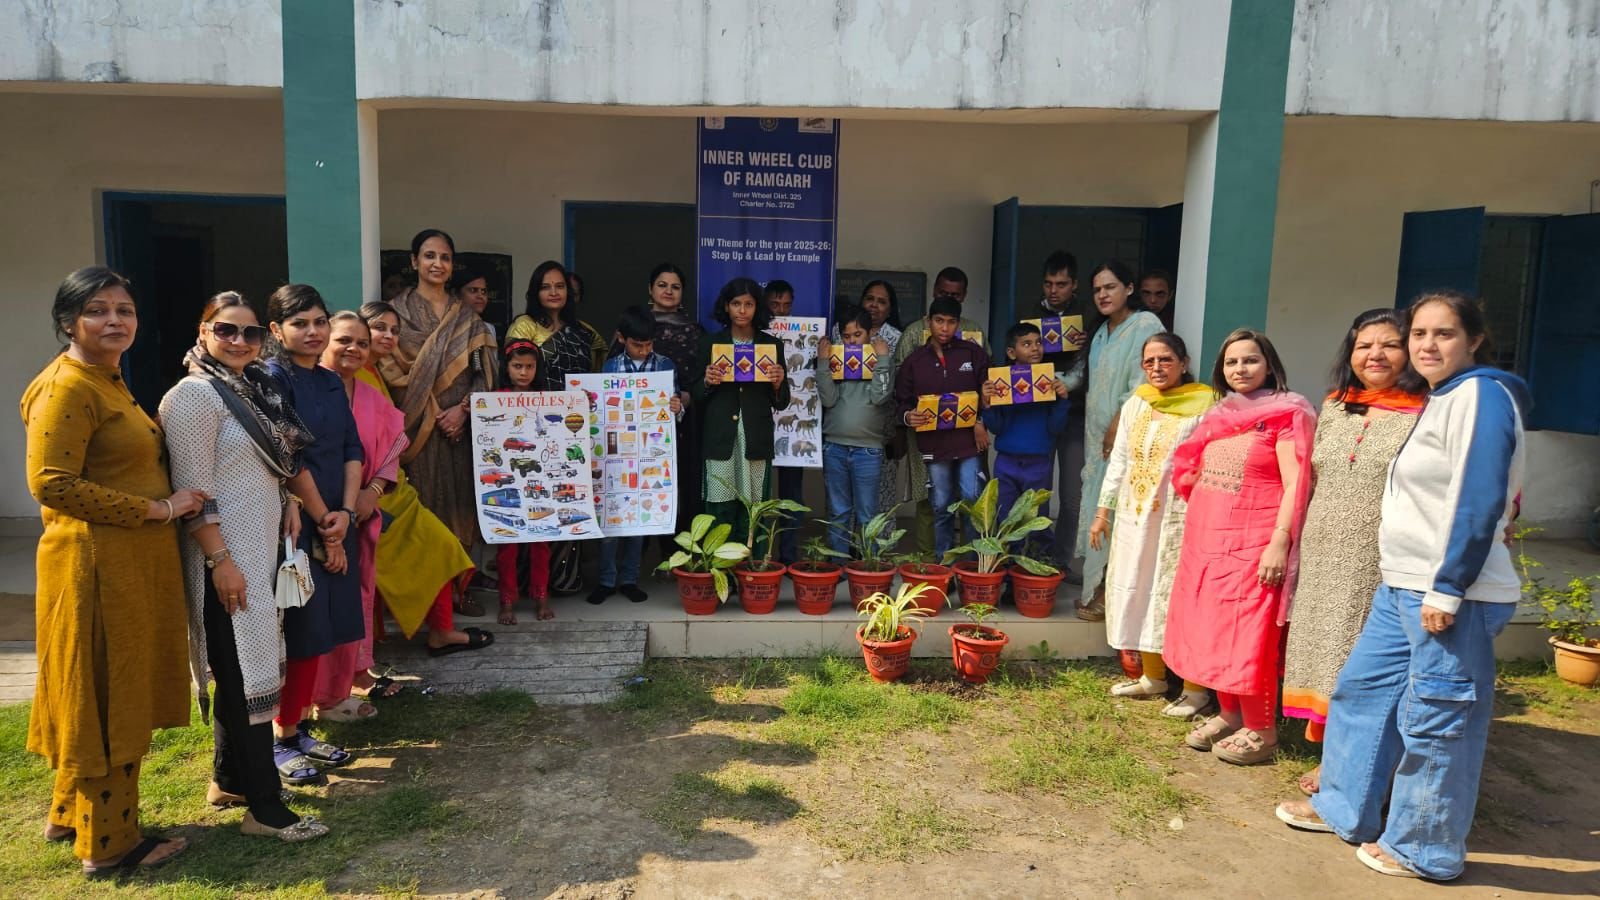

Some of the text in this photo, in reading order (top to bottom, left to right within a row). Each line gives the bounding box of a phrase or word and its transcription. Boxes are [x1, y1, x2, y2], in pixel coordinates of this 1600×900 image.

[703, 149, 832, 169] INNER WHEEL CLUB
[723, 170, 812, 188] OF RAMGARH
[732, 191, 802, 201] Inner Wheel Dist. 325
[740, 200, 764, 208] Charter
[701, 237, 832, 251] IIW Theme for the year 2025-26:
[711, 250, 821, 265] Step Up & Lead by Example
[773, 321, 819, 332] ANIMALS
[603, 378, 648, 390] SHAPES
[497, 394, 565, 408] VEHICLES
